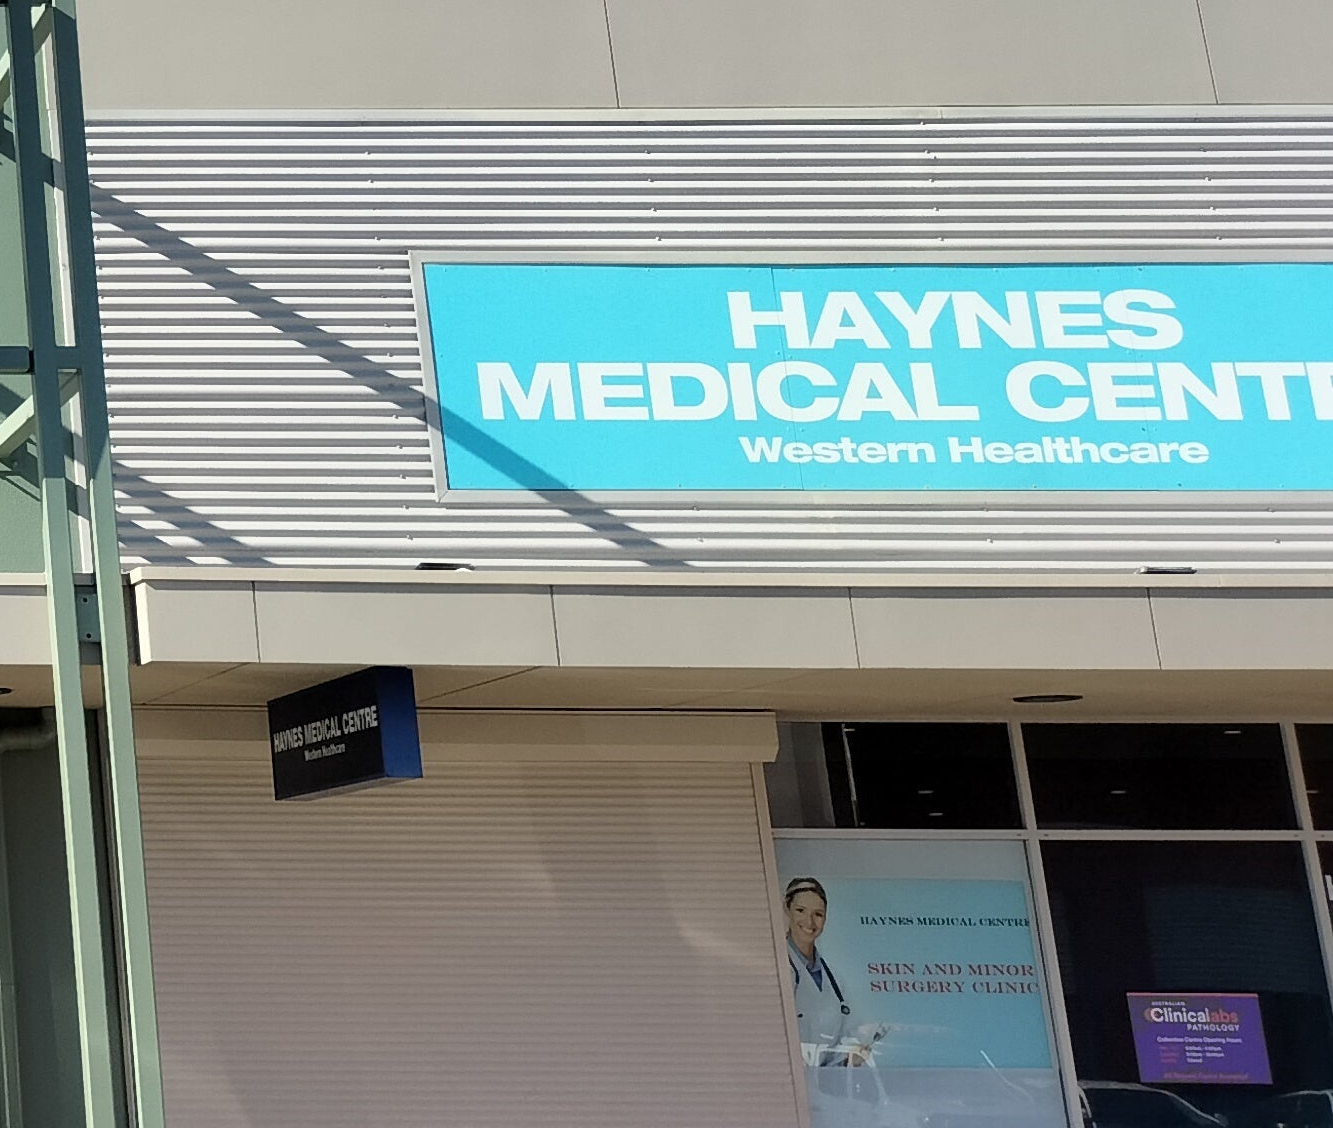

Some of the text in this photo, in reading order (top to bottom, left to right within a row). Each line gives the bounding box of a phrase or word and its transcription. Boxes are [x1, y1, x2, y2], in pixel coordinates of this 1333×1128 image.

[727, 289, 1184, 351] HAYNES
[476, 361, 979, 422] MEDICAL
[738, 435, 1210, 465] Western Healthcare
[273, 705, 378, 753] HAYNES MEDICAL CENTRE
[860, 916, 914, 926] HAYNES
[917, 917, 977, 927] MEDICAL
[867, 963, 1034, 977] SKIN AND MINOR
[870, 981, 965, 993] SURGERY
[1187, 1024, 1240, 1032] PATHOLOGY
